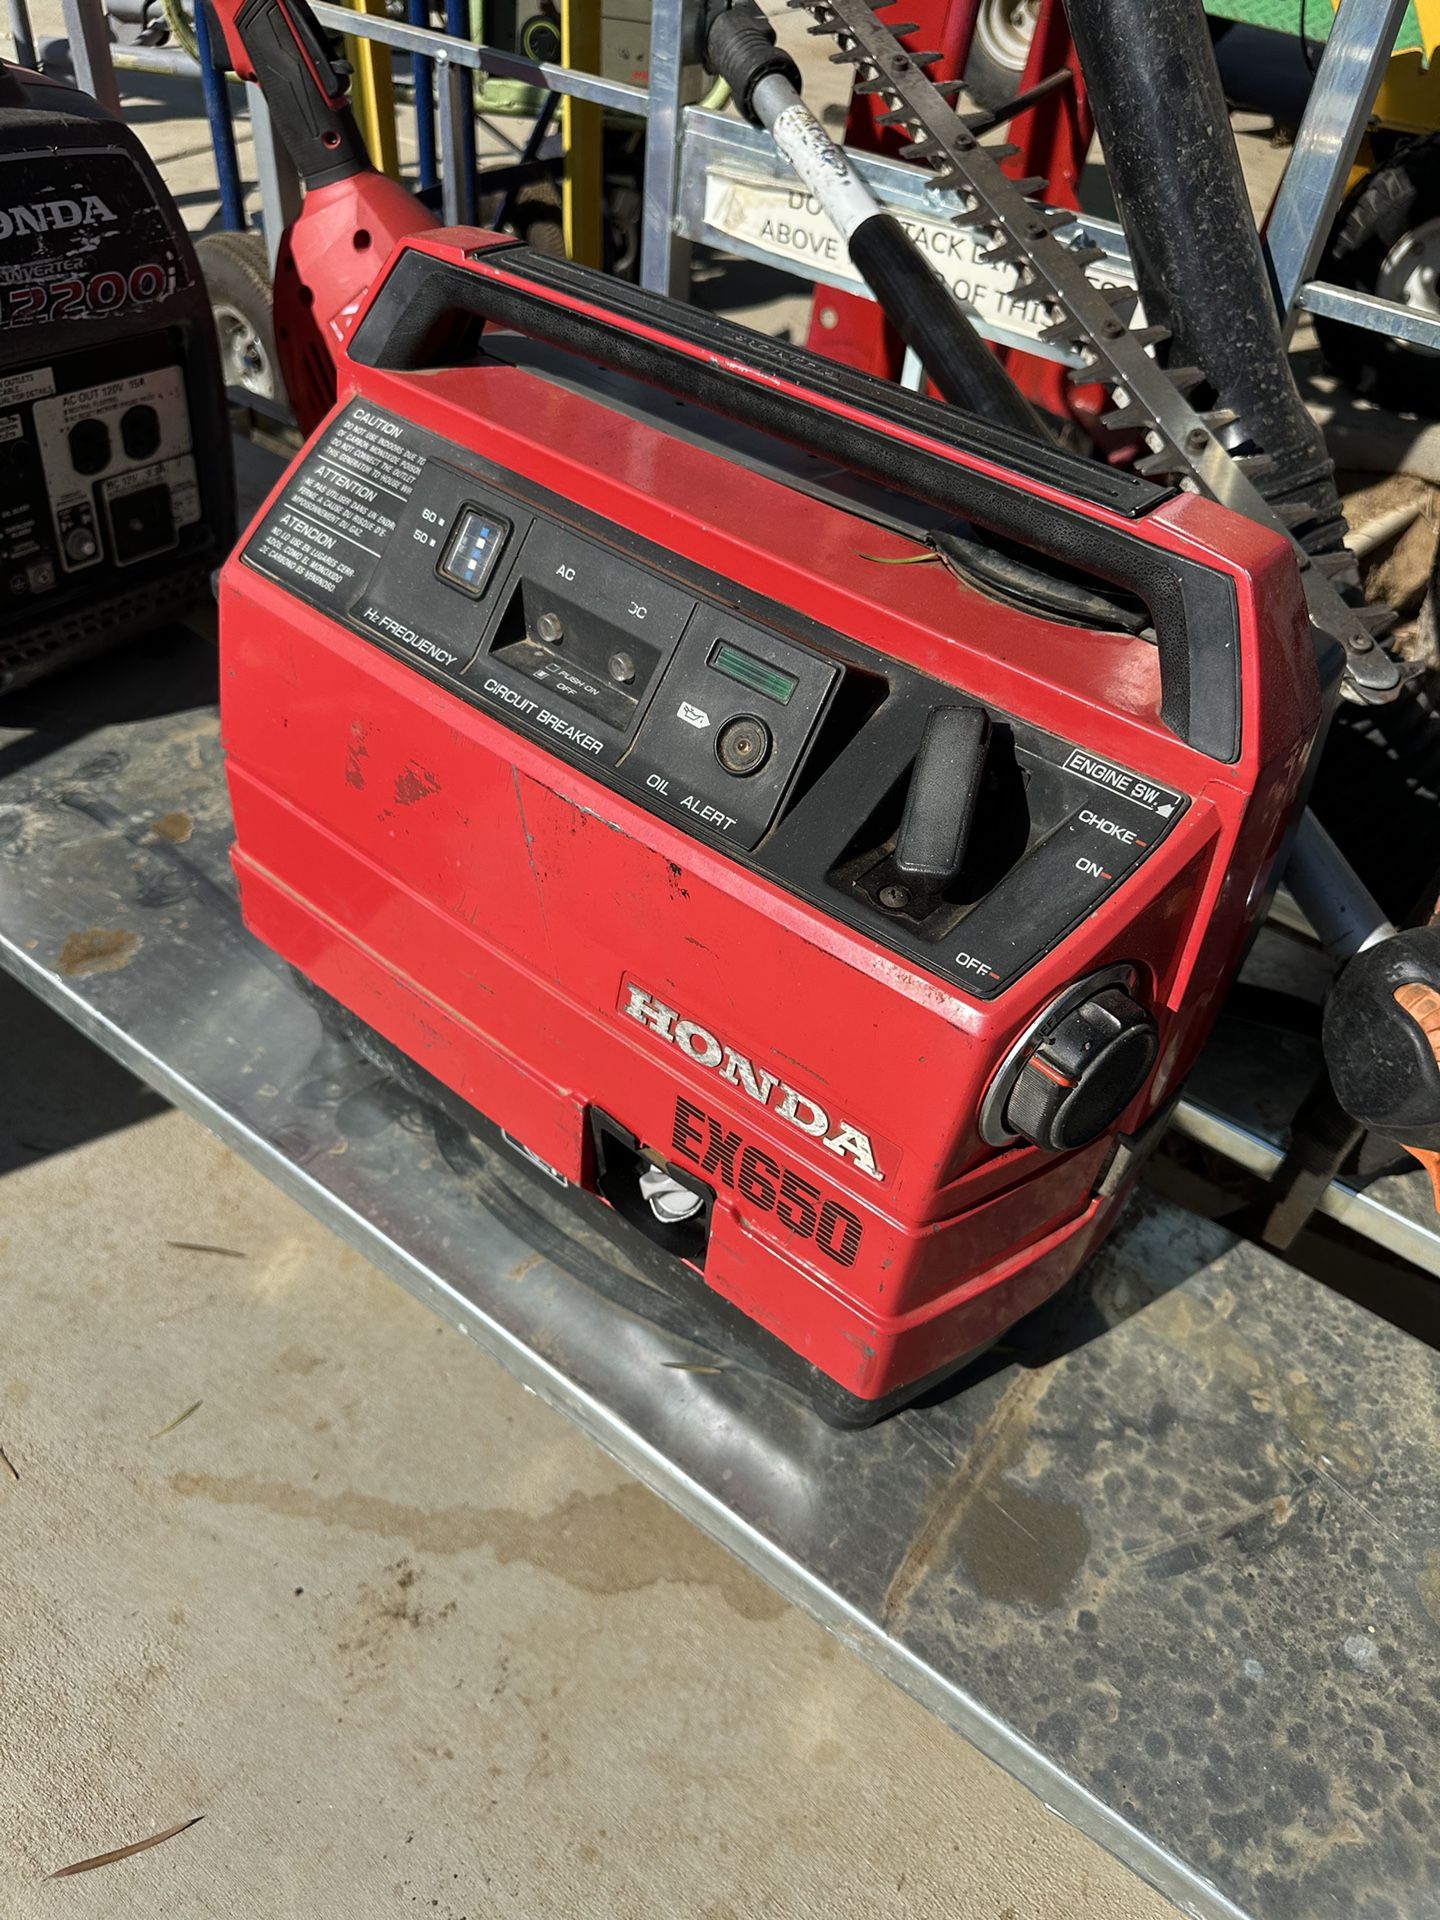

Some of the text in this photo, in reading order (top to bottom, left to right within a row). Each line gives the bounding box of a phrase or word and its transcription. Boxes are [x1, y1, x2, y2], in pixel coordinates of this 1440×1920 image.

[761, 219, 838, 260] ABOVE
[901, 221, 966, 261] TACK
[0, 250, 177, 330] 2200i
[952, 279, 987, 305] OF
[102, 382, 124, 397] 120V
[352, 408, 403, 438] CAUTION
[331, 438, 416, 484] DO NOT CONNECT THE OUTLET
[336, 428, 347, 438] OF
[345, 433, 370, 450] CARBON
[369, 445, 400, 465] MONOXIDE
[343, 420, 427, 466] DO NOT USE INDOORS DUE TO
[314, 465, 378, 502] ATTENTION
[325, 445, 340, 458] THIS
[338, 453, 373, 474] GENERATOR
[371, 468, 381, 479] TO
[380, 474, 401, 489] HOUSE
[297, 486, 319, 501] FERME
[322, 499, 344, 514] CAUSE
[342, 509, 354, 519] DU
[351, 514, 375, 531] RISQUE
[304, 477, 315, 487] NE
[313, 482, 327, 493] PAS
[325, 489, 352, 506] UTILISER
[350, 500, 369, 515] DANS
[366, 510, 379, 520] UN
[422, 507, 437, 523] 60
[280, 514, 337, 550] ATENCION
[338, 520, 351, 529] DU
[412, 528, 429, 544] 50
[259, 544, 270, 554] DE
[268, 550, 297, 570] CARBONO
[295, 565, 306, 575] ES
[271, 526, 283, 536] NO
[280, 531, 291, 541] LO
[290, 536, 304, 548] USE
[301, 543, 313, 553] EN
[310, 548, 338, 568] LUGARES
[283, 546, 303, 560] COMO
[301, 555, 310, 565] EL
[309, 561, 343, 583] MONOXIDO
[556, 563, 576, 581] AC
[363, 607, 458, 666] Hz FREQUENCY
[556, 682, 578, 695] OFF
[557, 670, 600, 695] PUSH ON
[483, 678, 604, 755] CIRCUIT BREAKER
[1069, 753, 1158, 806] ENGINE SW.
[646, 773, 737, 831] OIL ALERT
[1078, 809, 1137, 845] CHOKE
[1075, 858, 1104, 878] ON
[955, 952, 992, 977] OFF
[624, 980, 886, 1182] HONDA
[671, 1095, 864, 1268] EX650
